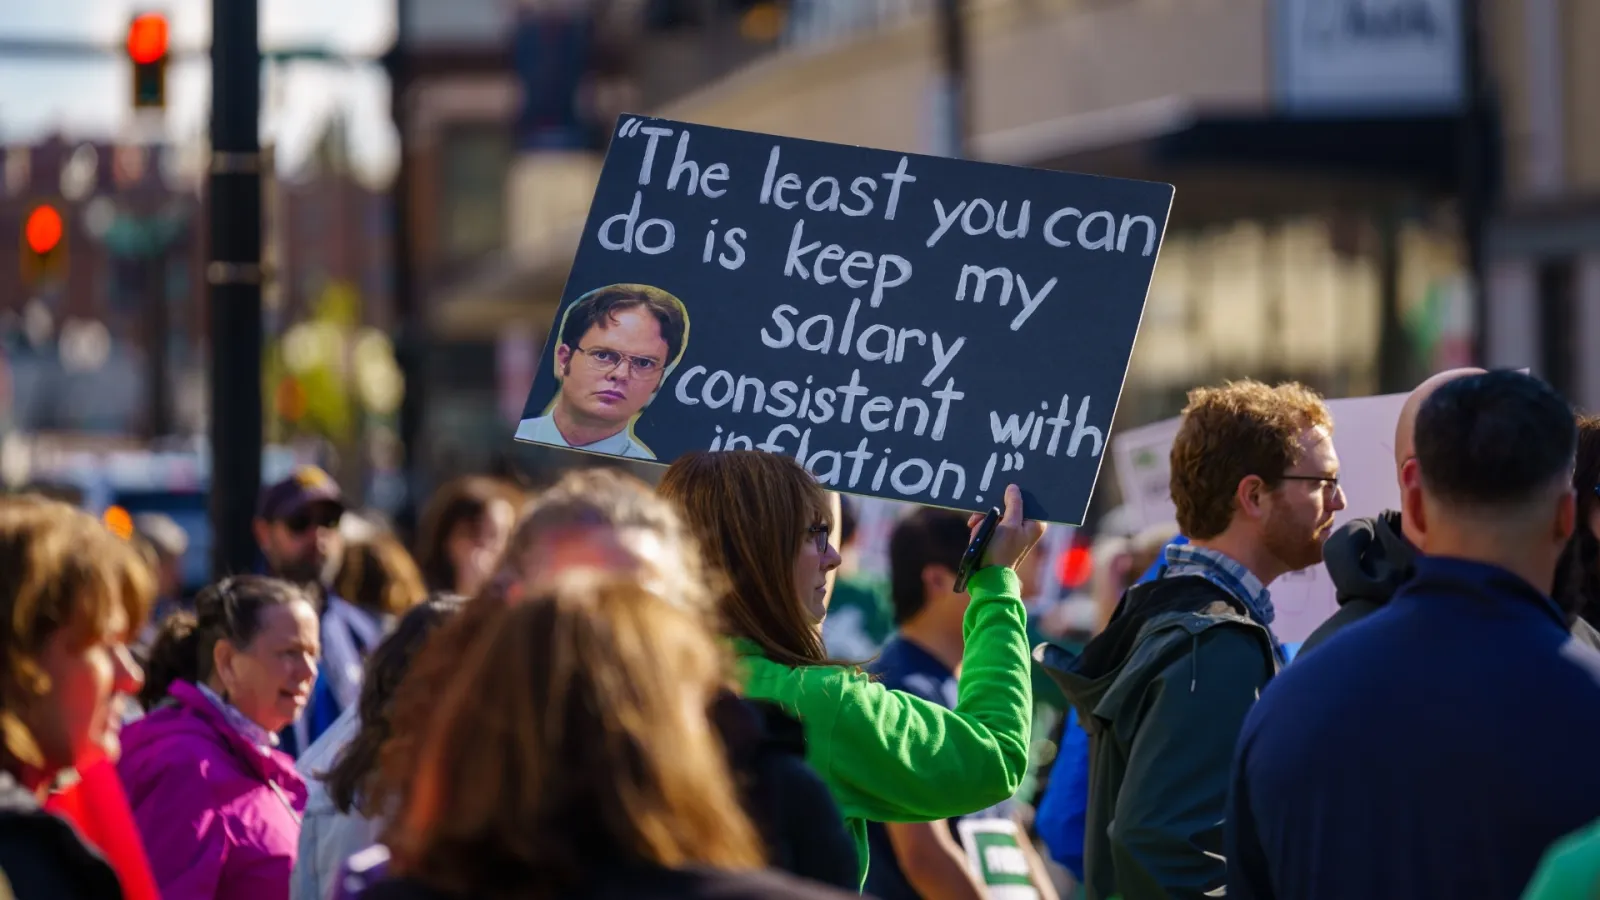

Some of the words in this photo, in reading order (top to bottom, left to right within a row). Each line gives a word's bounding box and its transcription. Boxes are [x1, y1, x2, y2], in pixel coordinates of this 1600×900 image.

[619, 118, 730, 199] “The
[759, 145, 917, 220] least
[926, 198, 1030, 247] you
[1043, 207, 1156, 257] can
[598, 190, 676, 255] do
[702, 218, 747, 270] is
[784, 218, 913, 307] keep
[955, 263, 1058, 331] my
[760, 298, 967, 387] salary
[675, 364, 965, 441] consistent
[990, 394, 1103, 458] with
